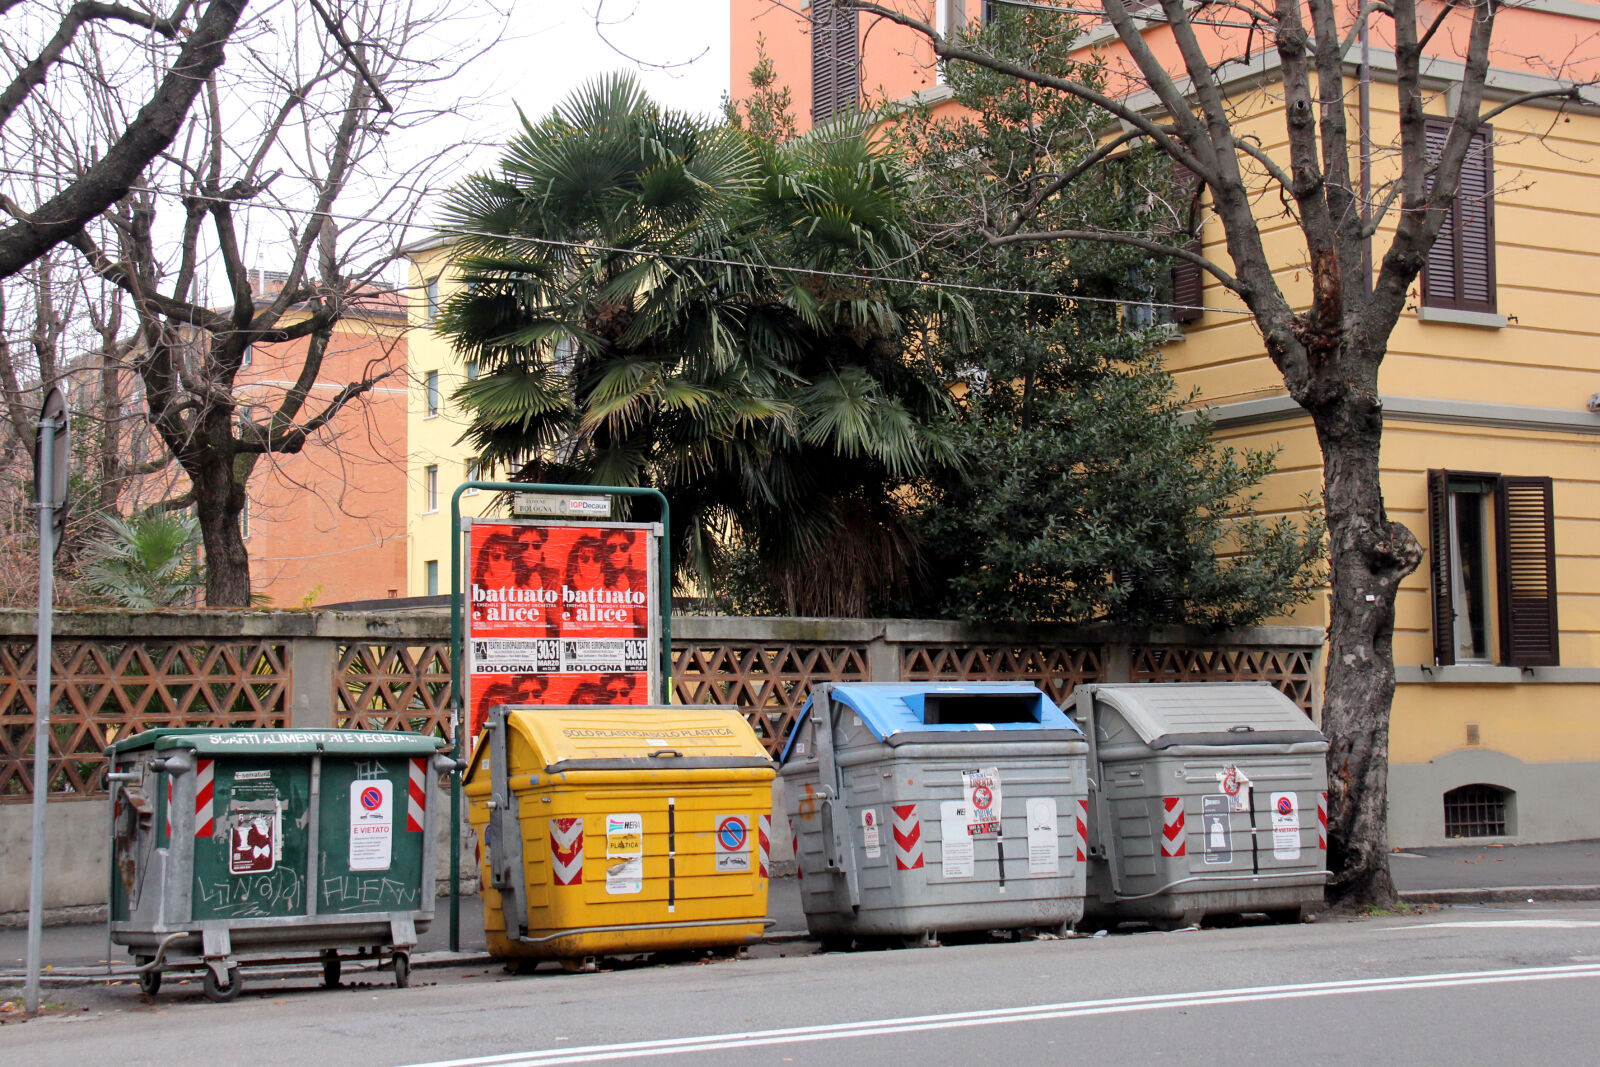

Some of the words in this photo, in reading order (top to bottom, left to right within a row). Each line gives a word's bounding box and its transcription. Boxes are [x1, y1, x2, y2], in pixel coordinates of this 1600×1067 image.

[520, 505, 552, 513] BOLOGNA
[571, 501, 607, 510] IGPDecaux
[472, 584, 558, 602] battiato
[561, 585, 646, 604] battiato
[472, 611, 482, 620] e
[486, 603, 540, 622] alice
[562, 612, 570, 620] e
[576, 604, 627, 622] alice
[488, 642, 502, 650] TEATRO
[578, 642, 592, 650] TEATRO
[562, 730, 594, 738] SOLO
[681, 728, 734, 736] PLASTICA
[344, 734, 354, 743] E
[360, 826, 390, 834] VIETATO
[624, 821, 640, 830] HERA
